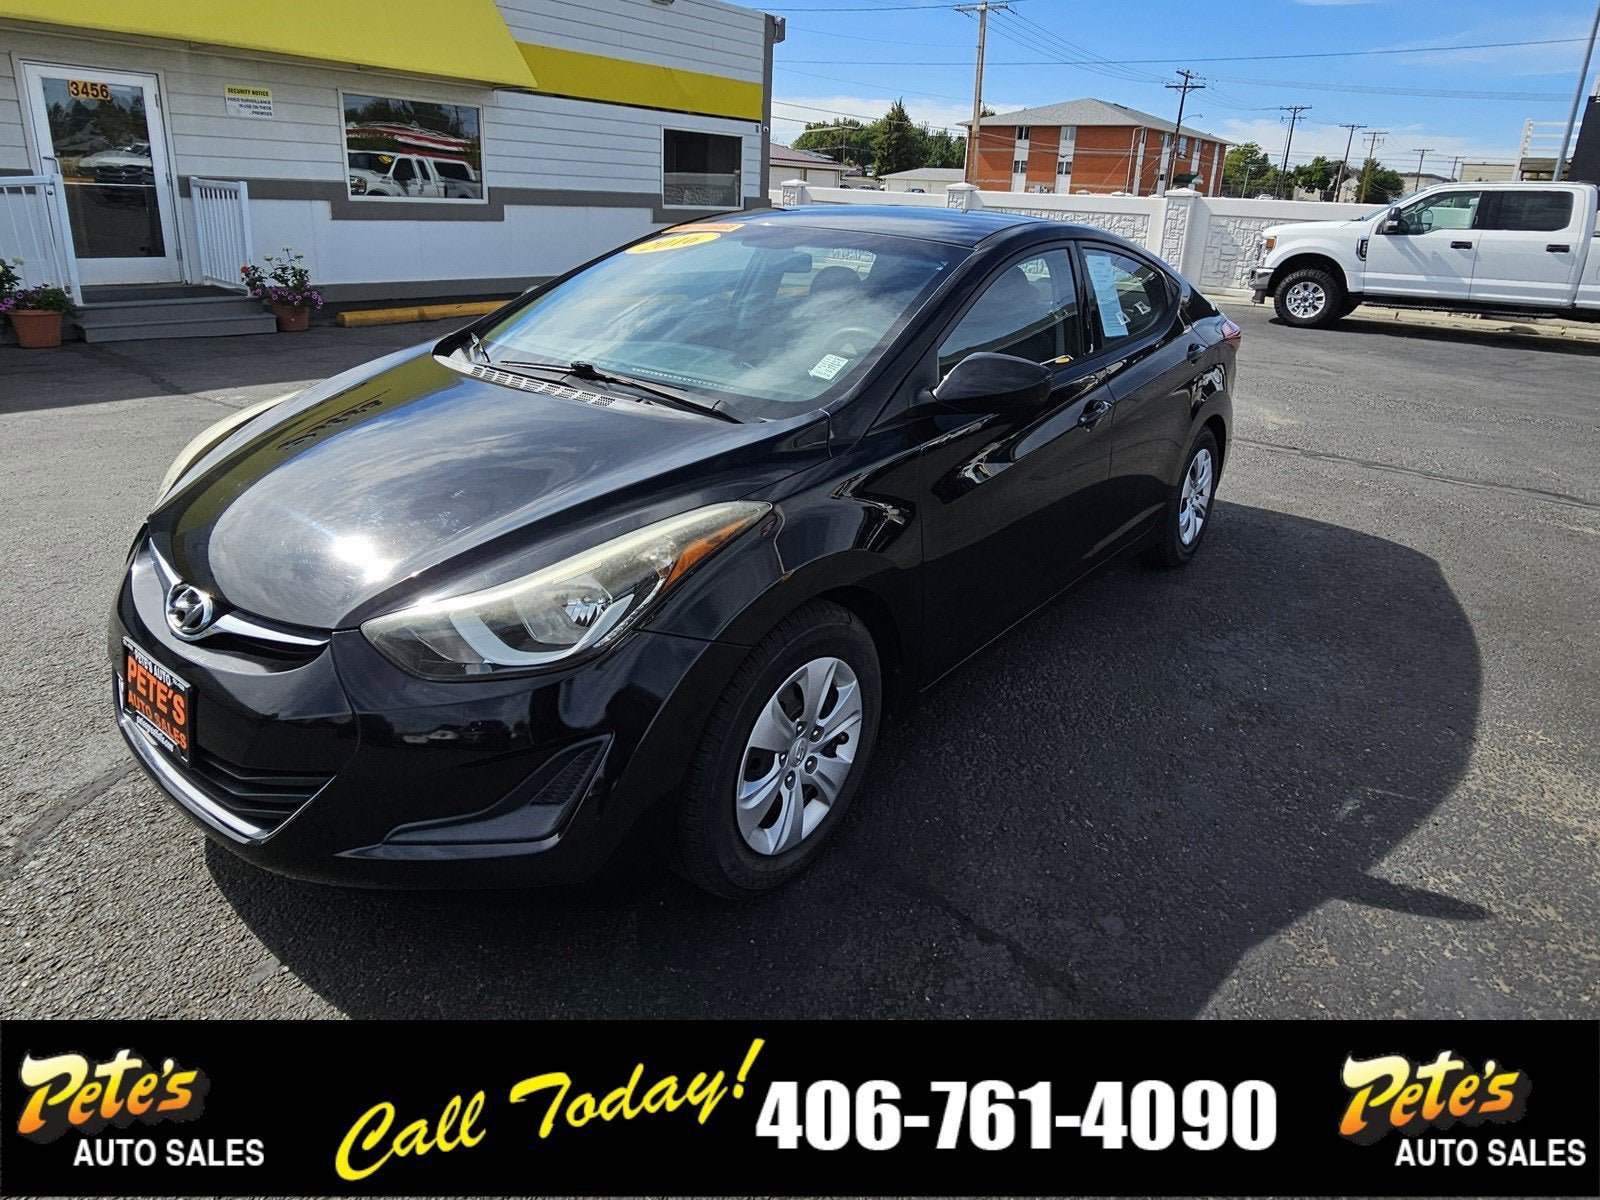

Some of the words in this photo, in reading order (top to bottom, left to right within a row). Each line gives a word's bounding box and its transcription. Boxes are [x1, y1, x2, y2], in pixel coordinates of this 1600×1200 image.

[69, 80, 109, 99] 3456
[227, 87, 251, 95] SECURITY
[127, 655, 186, 726] PETE'S
[128, 690, 153, 720] AUTO
[154, 712, 187, 750] SALES
